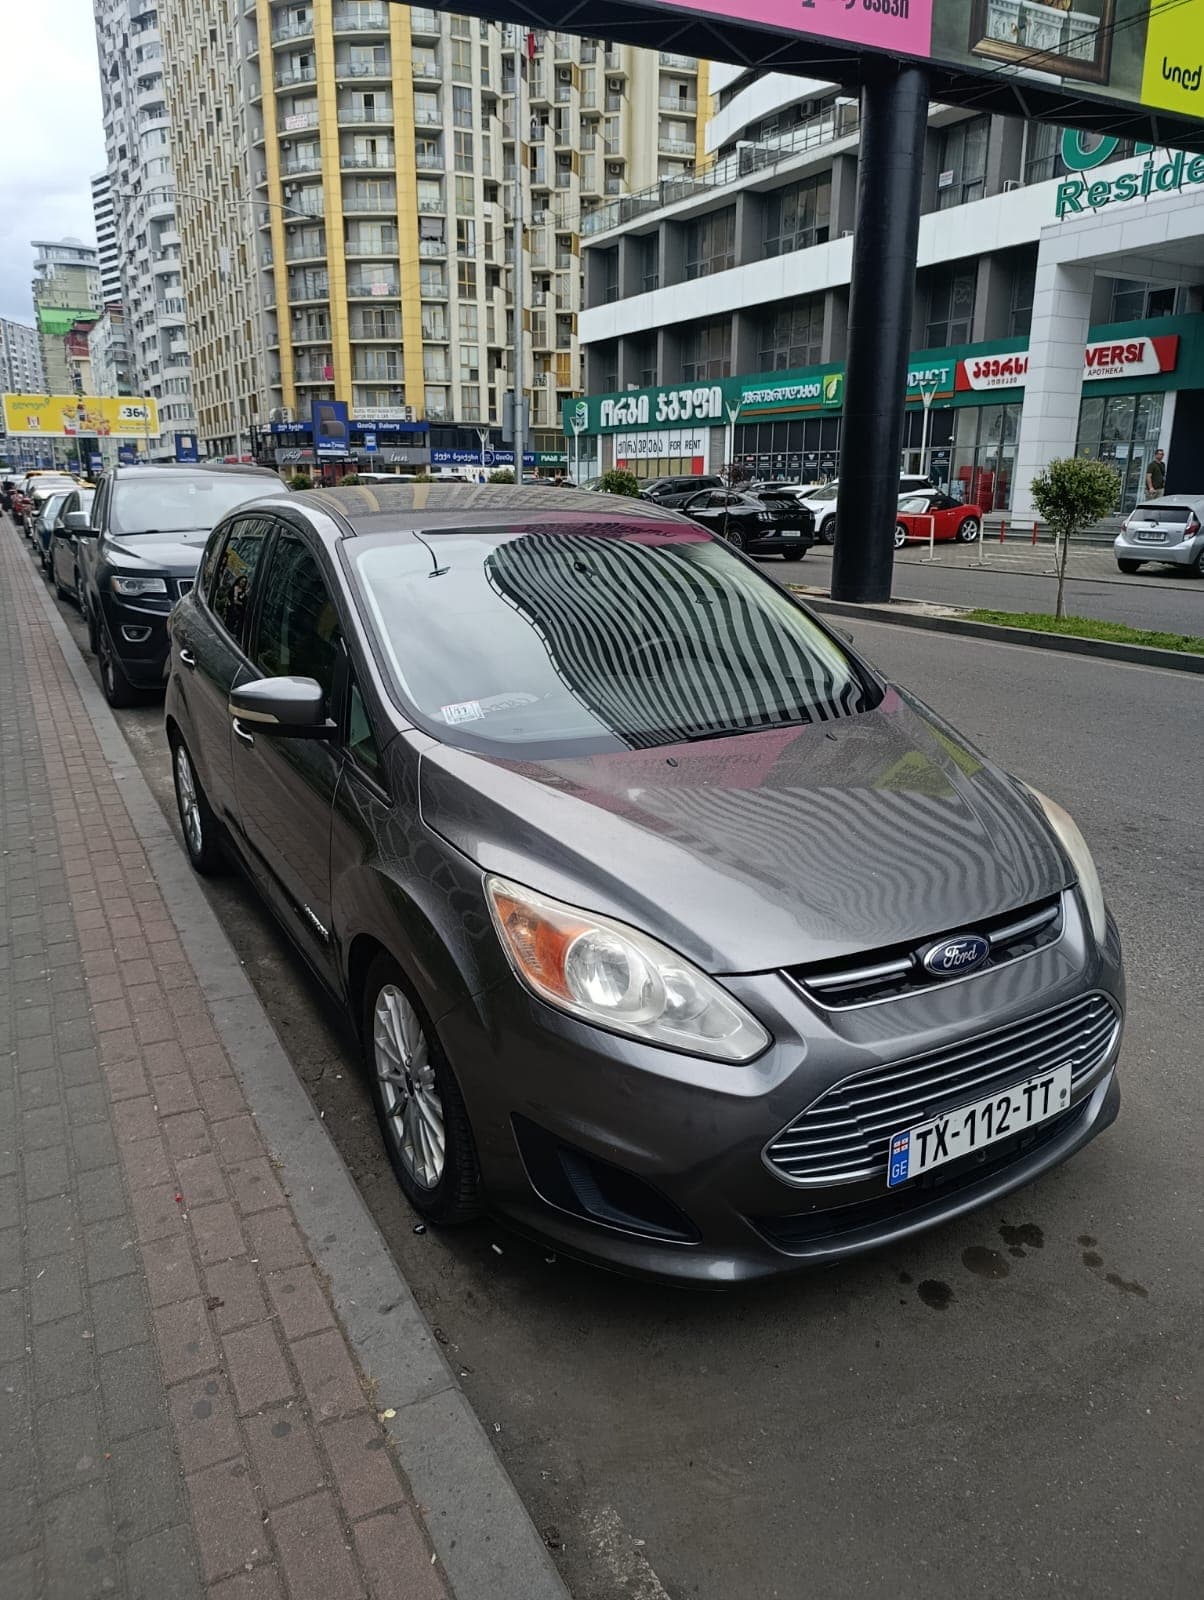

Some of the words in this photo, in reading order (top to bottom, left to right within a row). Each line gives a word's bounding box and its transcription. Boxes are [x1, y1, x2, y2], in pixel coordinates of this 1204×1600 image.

[1085, 343, 1145, 367] VERSI
[600, 395, 649, 427] ორბი
[655, 386, 722, 422] ჯგუფი
[669, 440, 681, 451] FOR
[684, 439, 702, 450] RENT
[942, 943, 978, 968] Ford
[916, 1078, 1055, 1169] TX-112-TT
[891, 1158, 908, 1178] GE
